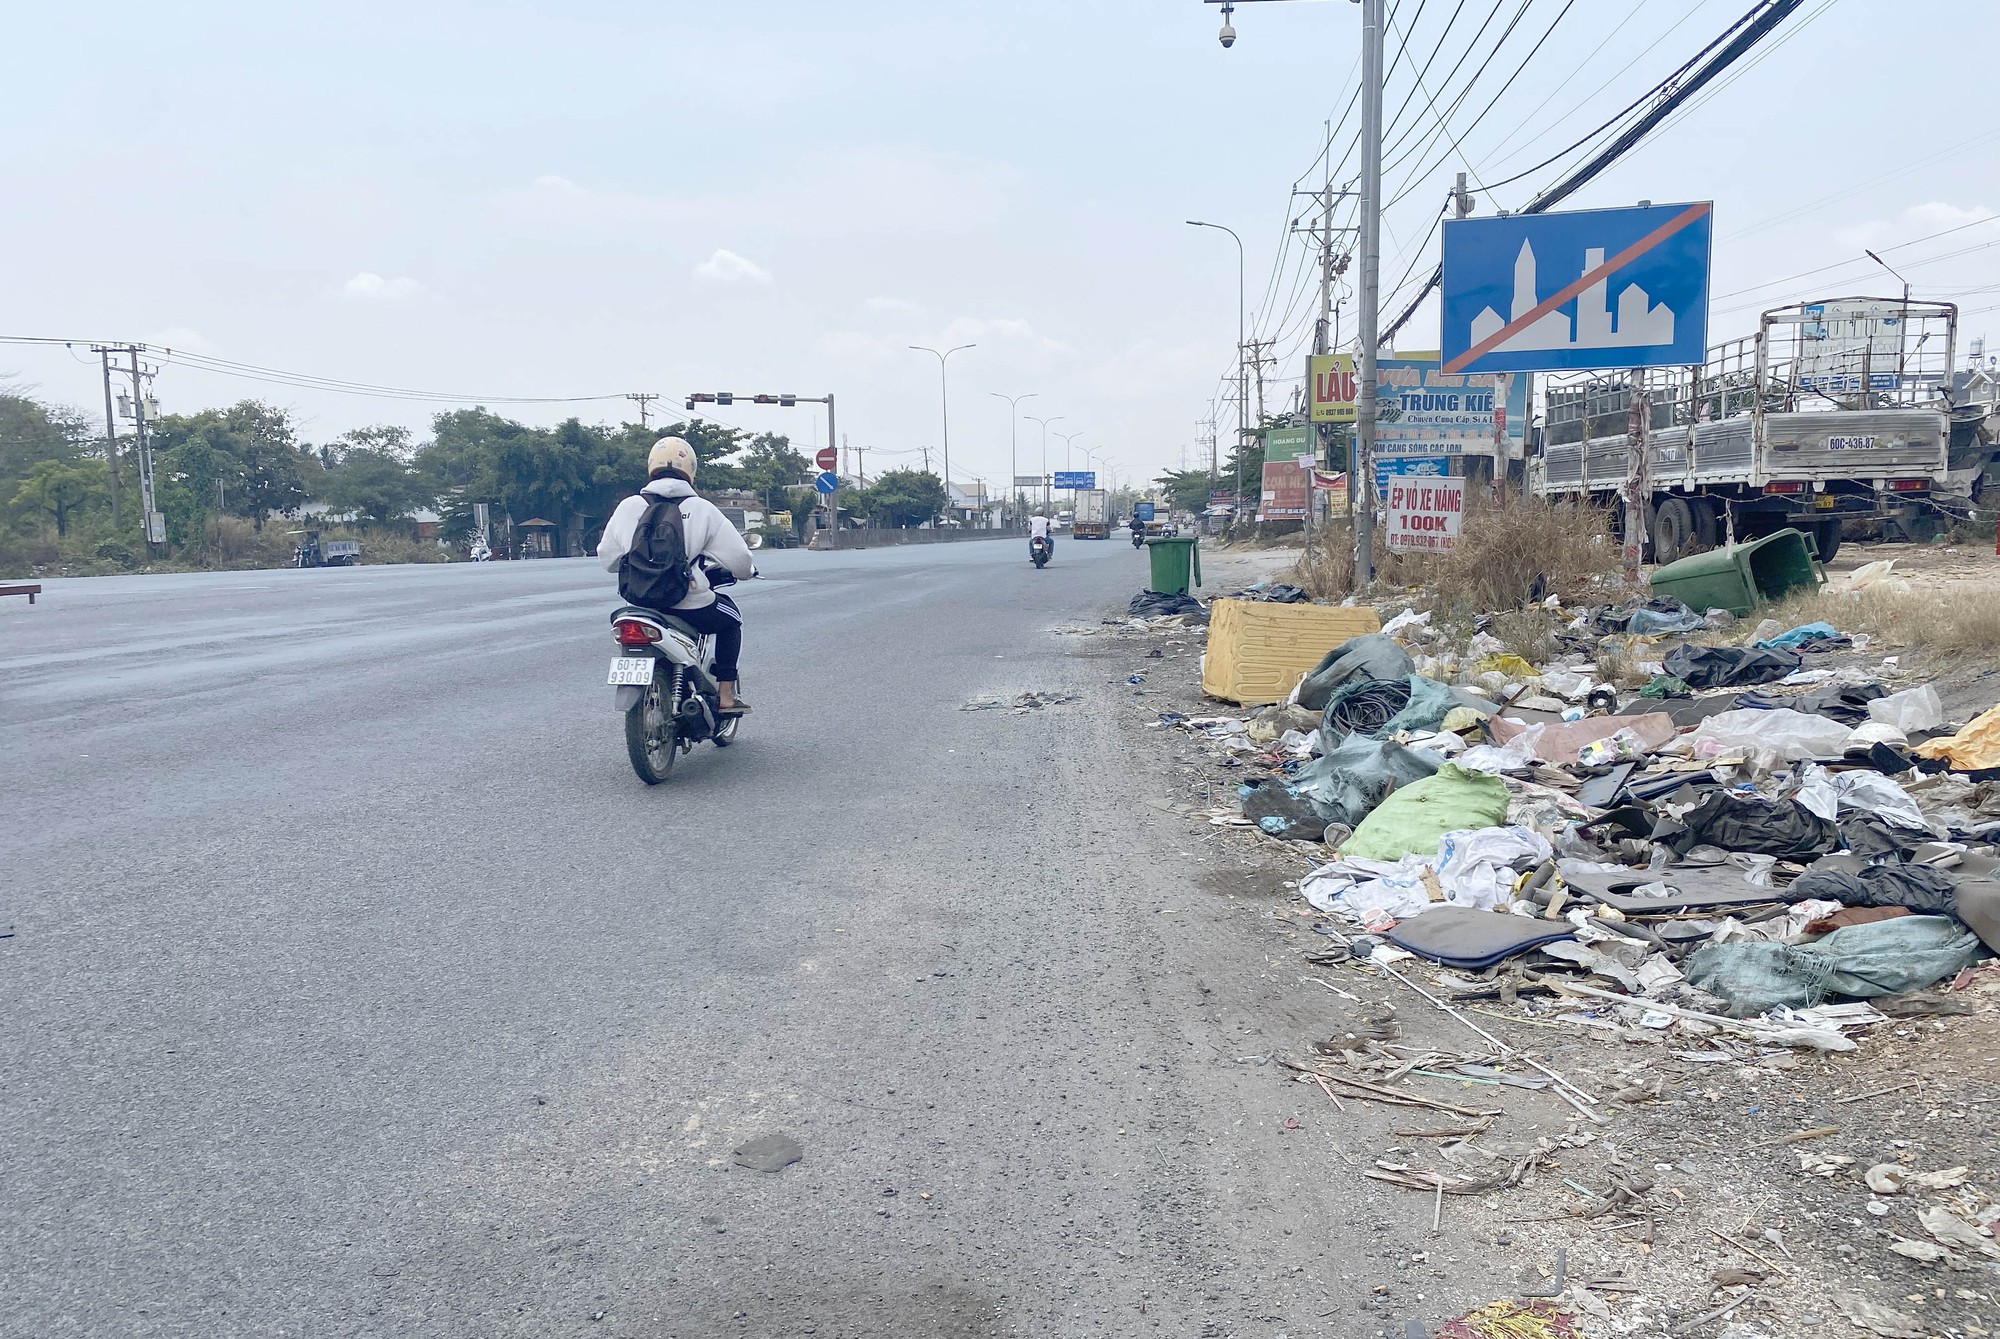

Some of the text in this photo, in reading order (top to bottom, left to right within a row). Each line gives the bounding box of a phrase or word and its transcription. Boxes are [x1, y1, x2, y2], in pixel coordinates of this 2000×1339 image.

[1400, 393, 1459, 412] TRUNG
[1829, 437, 1875, 450] 60C-436.87
[1391, 480, 1462, 513] ÉP VỎ XE NÂNG
[1400, 514, 1448, 532] 100K
[617, 659, 648, 671] 60-F3
[610, 671, 650, 684] 930.09
